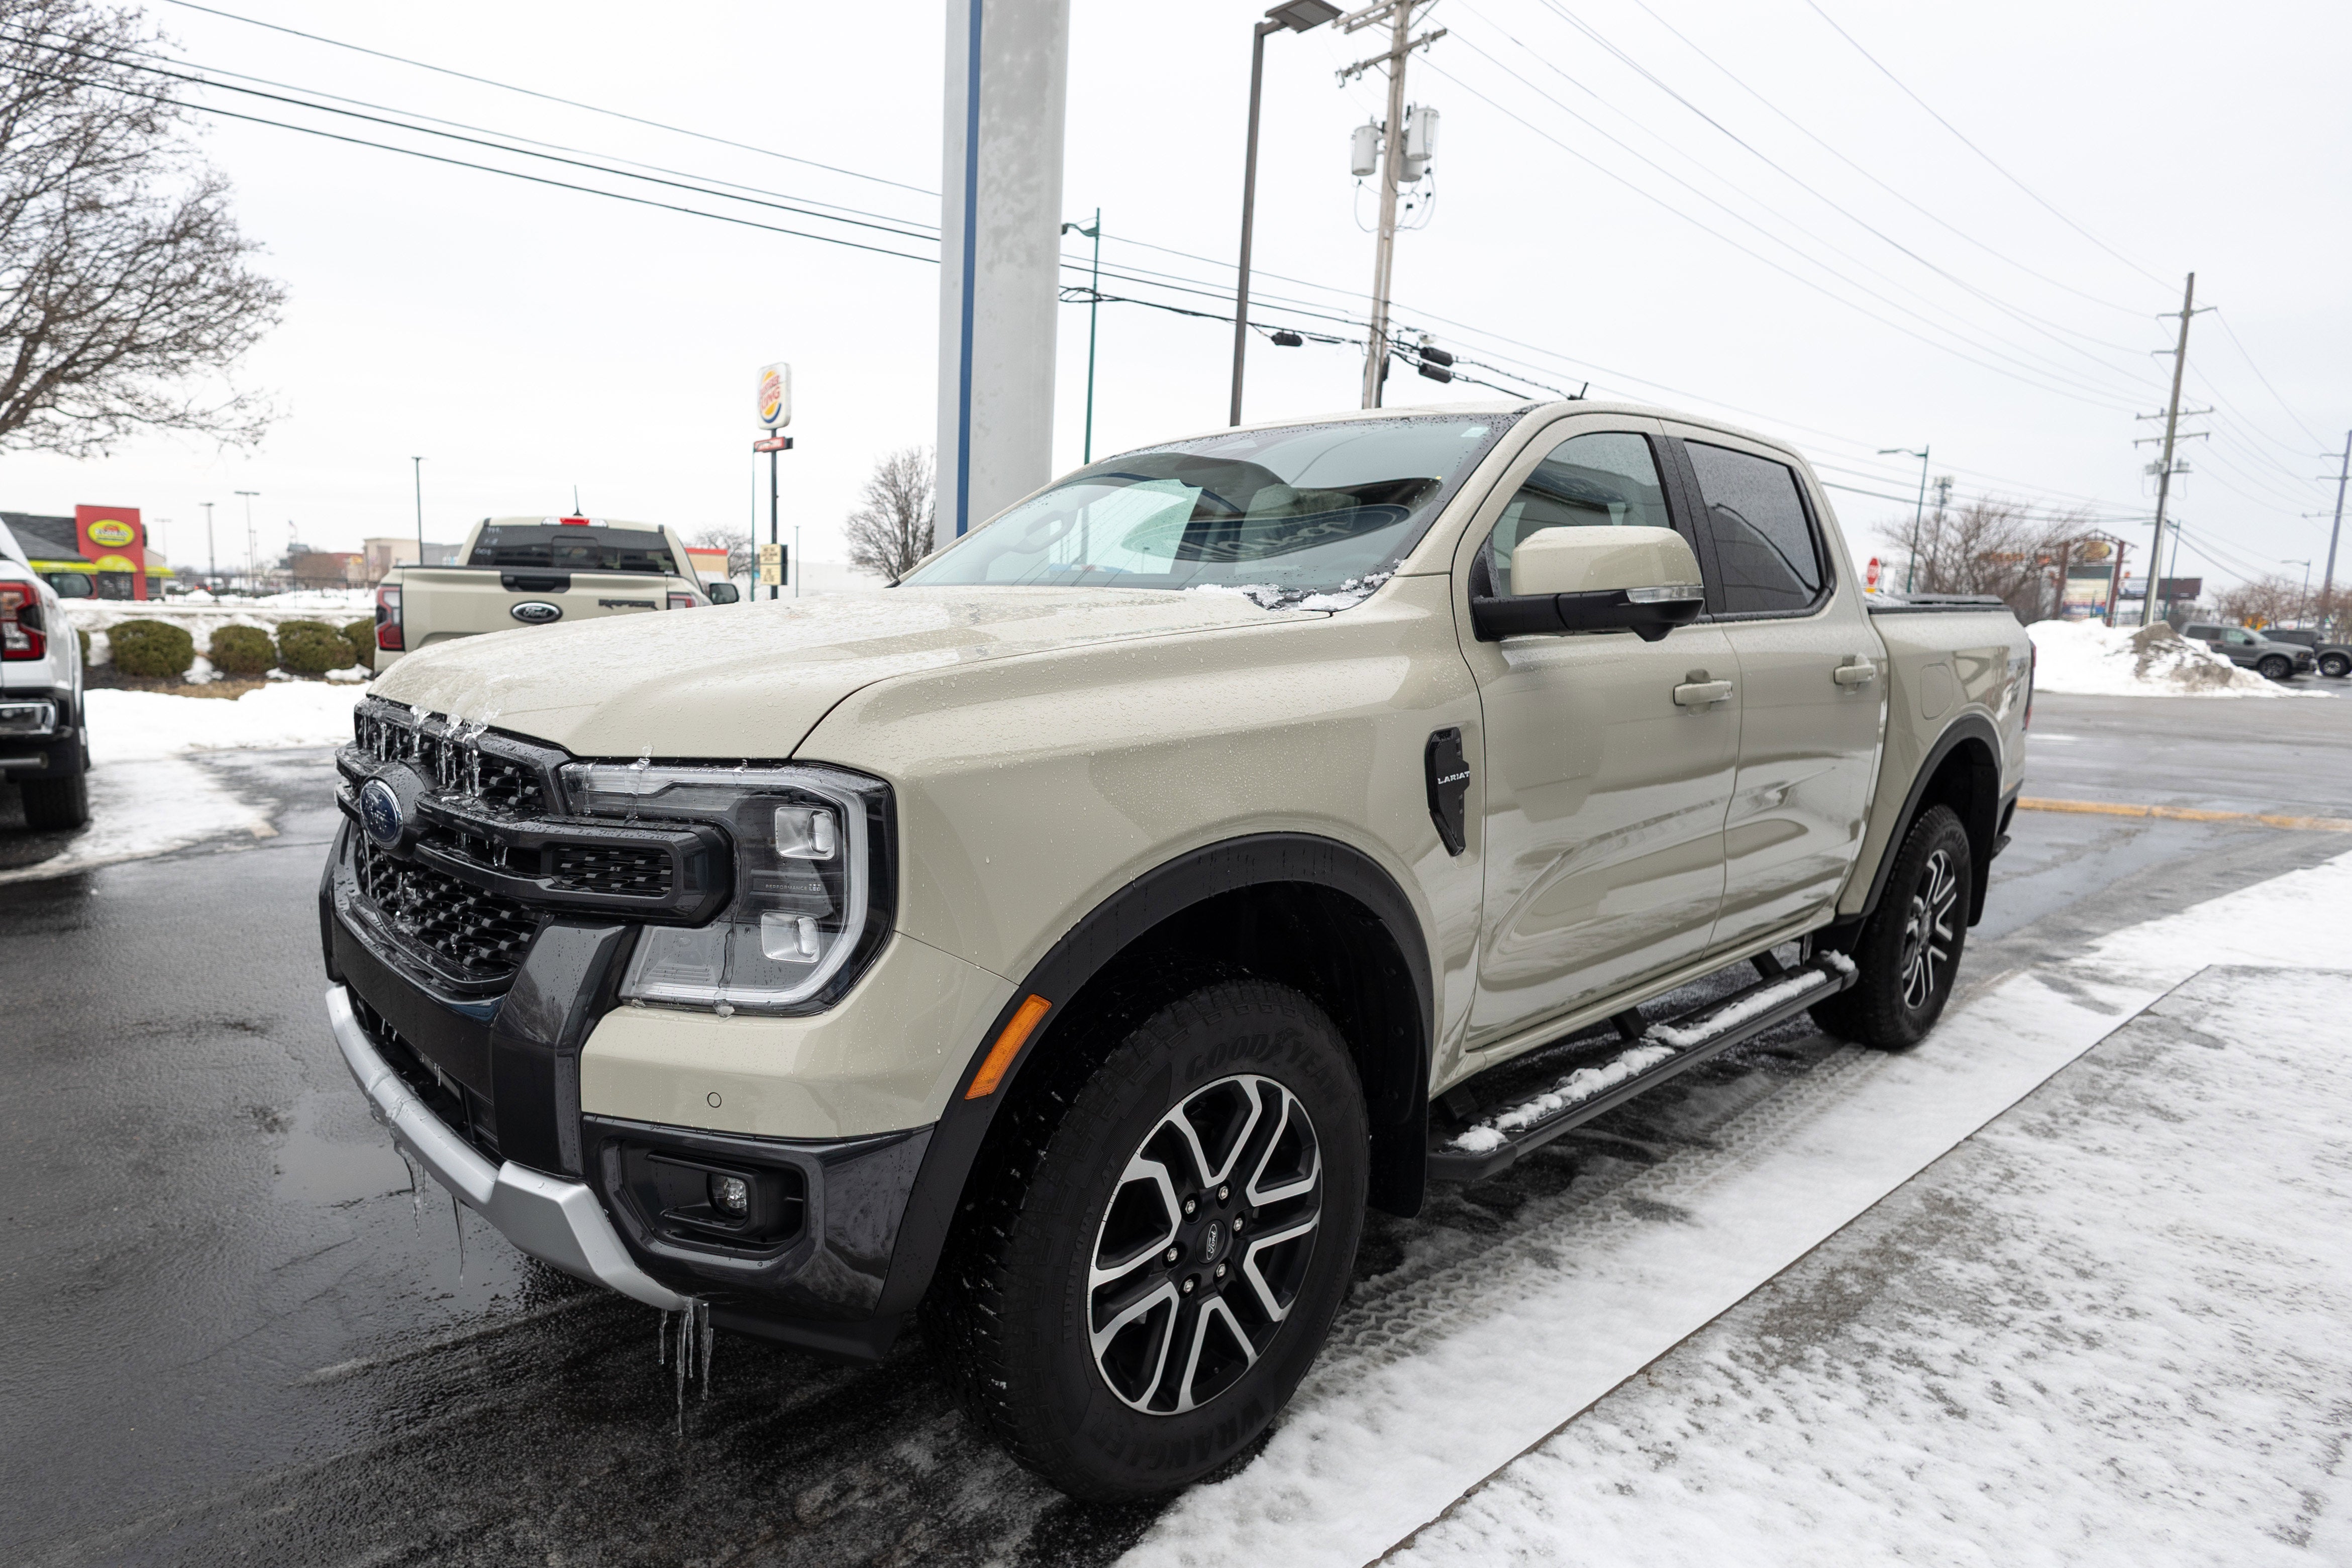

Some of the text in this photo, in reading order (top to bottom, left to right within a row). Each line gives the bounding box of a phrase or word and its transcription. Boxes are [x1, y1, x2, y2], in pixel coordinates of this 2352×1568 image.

[523, 606, 548, 617] Ford
[1438, 771, 1470, 784] LARIAT
[1208, 1231, 1216, 1253] Ford
[1089, 1399, 1266, 1470] WRANGLER
